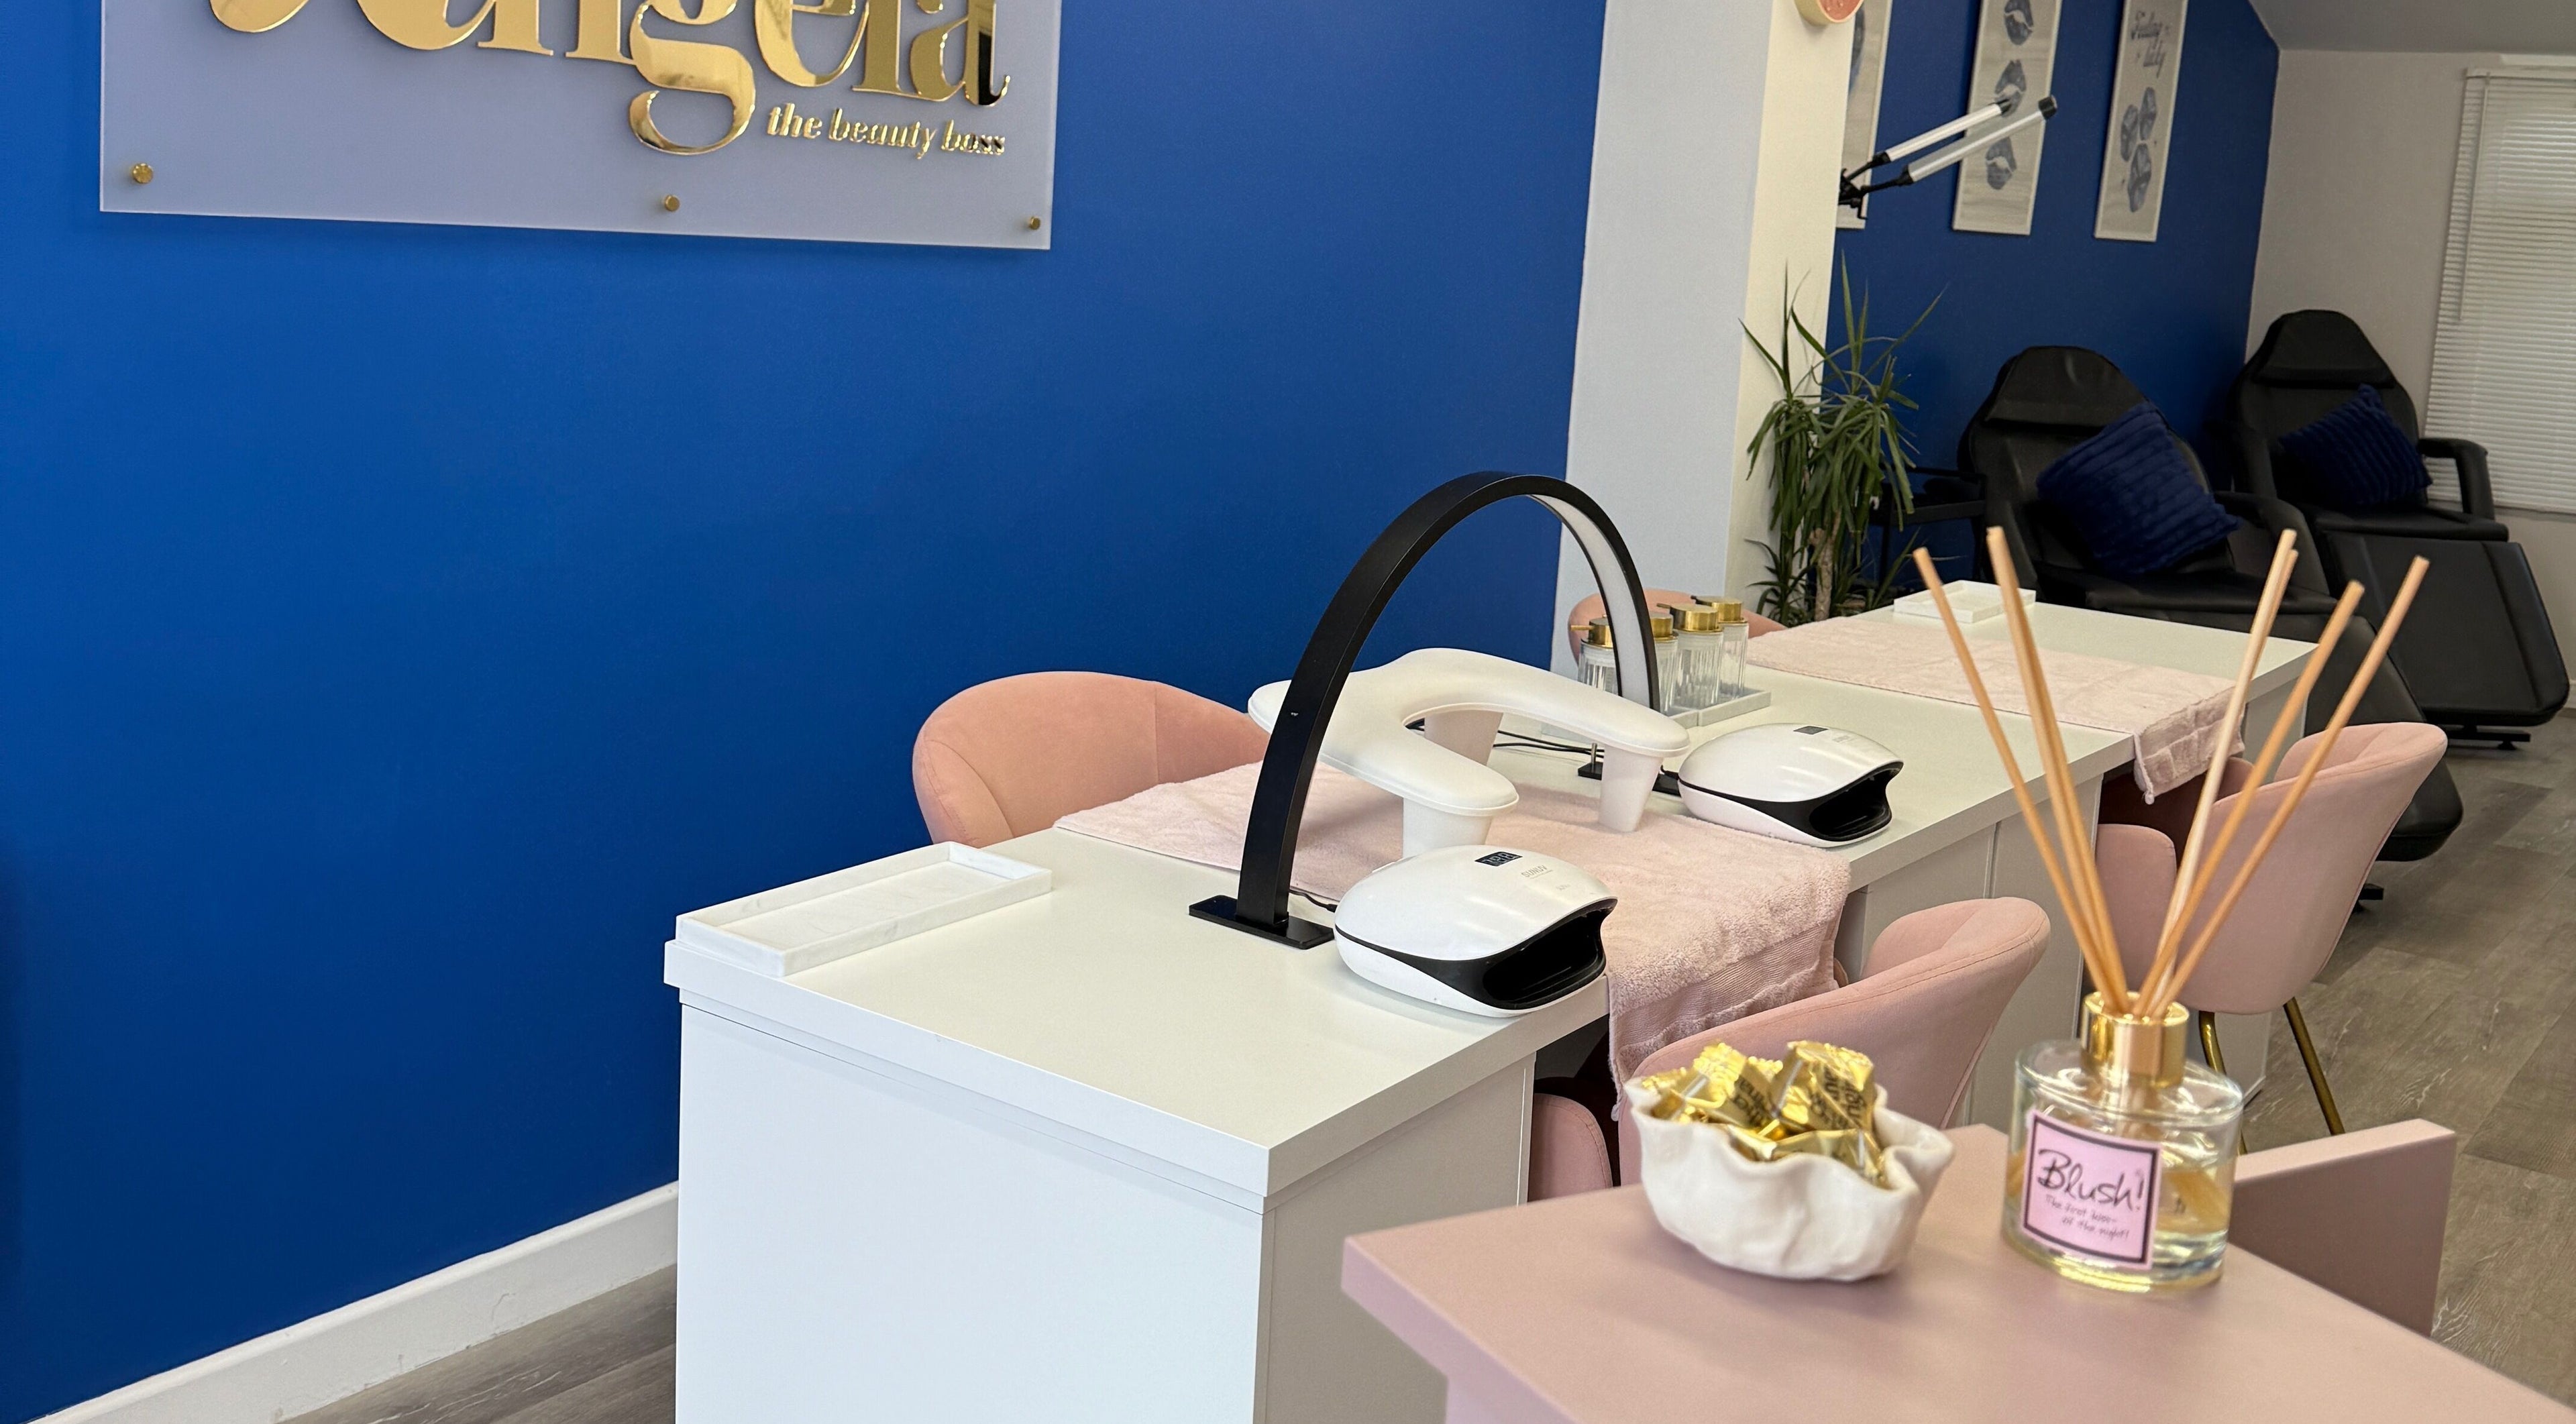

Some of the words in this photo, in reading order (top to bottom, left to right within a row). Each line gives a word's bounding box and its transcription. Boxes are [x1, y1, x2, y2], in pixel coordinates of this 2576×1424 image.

[767, 102, 823, 140] the
[828, 107, 938, 160] beauty
[941, 119, 1006, 156] boss
[2037, 1148, 2145, 1212] Blush!
[2046, 1194, 2061, 1209] The
